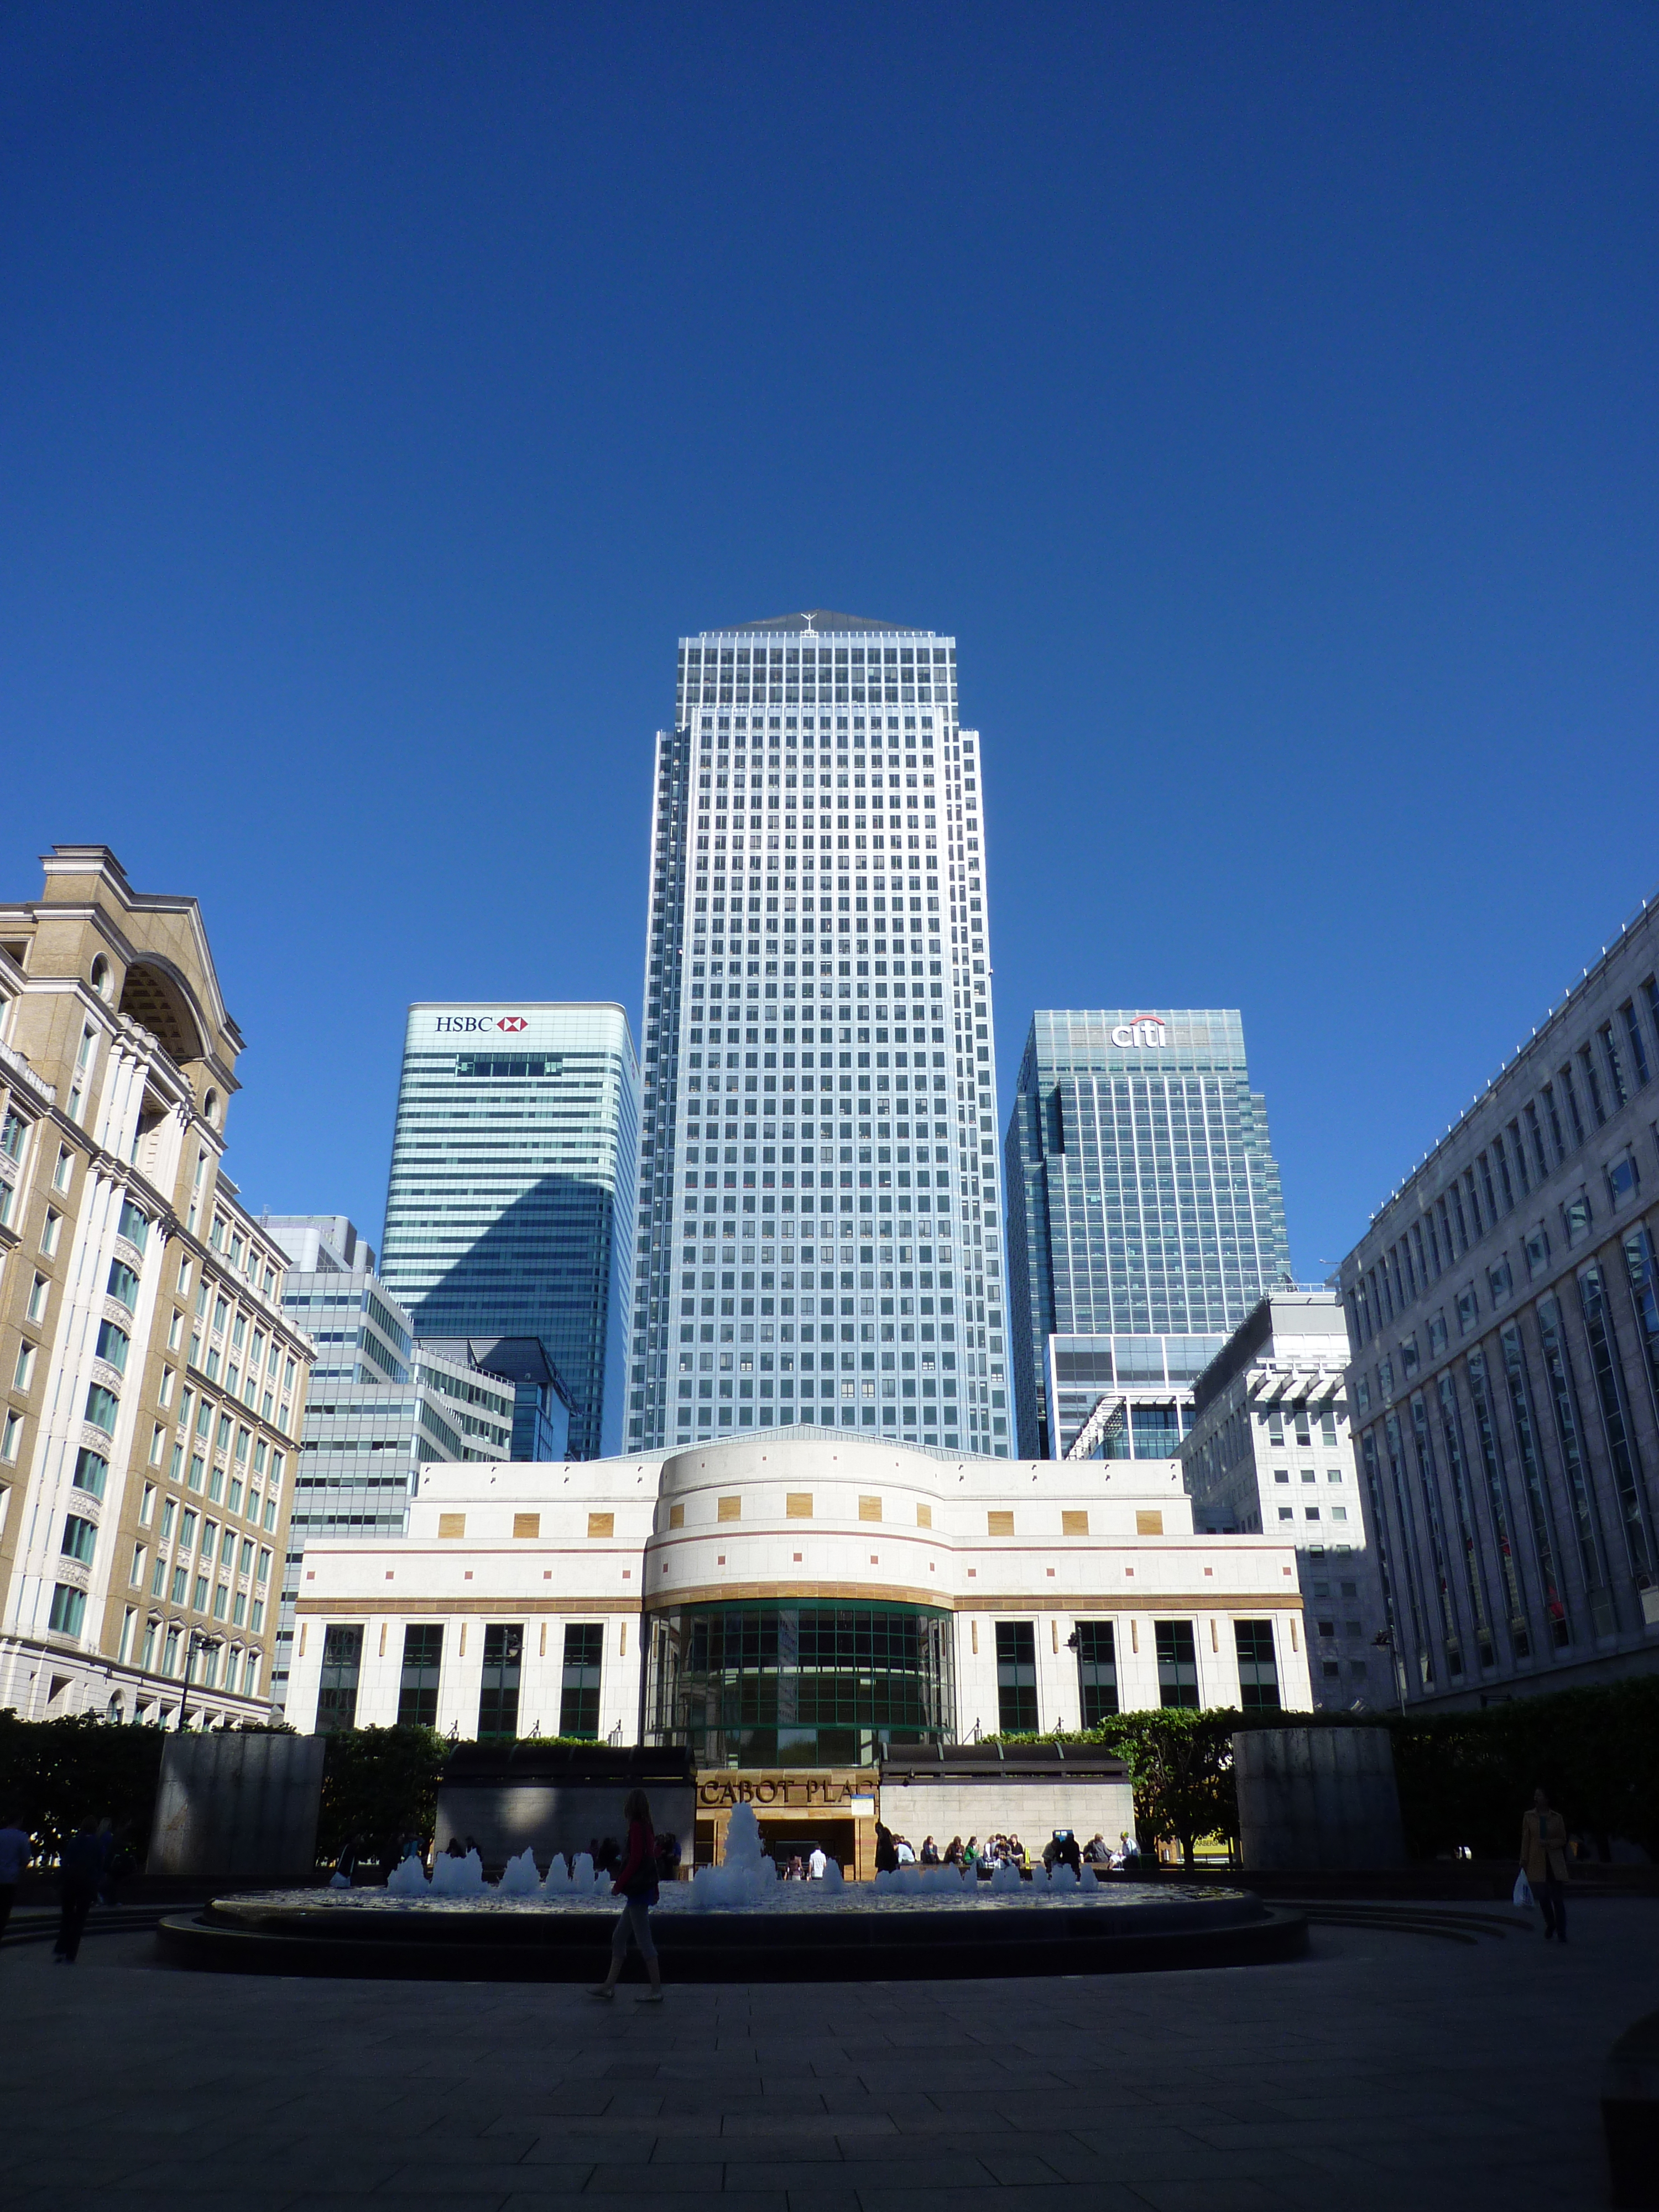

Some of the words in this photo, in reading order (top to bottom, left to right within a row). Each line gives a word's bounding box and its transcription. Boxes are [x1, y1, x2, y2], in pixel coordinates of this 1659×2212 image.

[435, 1016, 493, 1032] HSBC
[1111, 1019, 1166, 1048] citi
[700, 1779, 795, 1804] CABOT
[806, 1779, 878, 1803] PLAC
